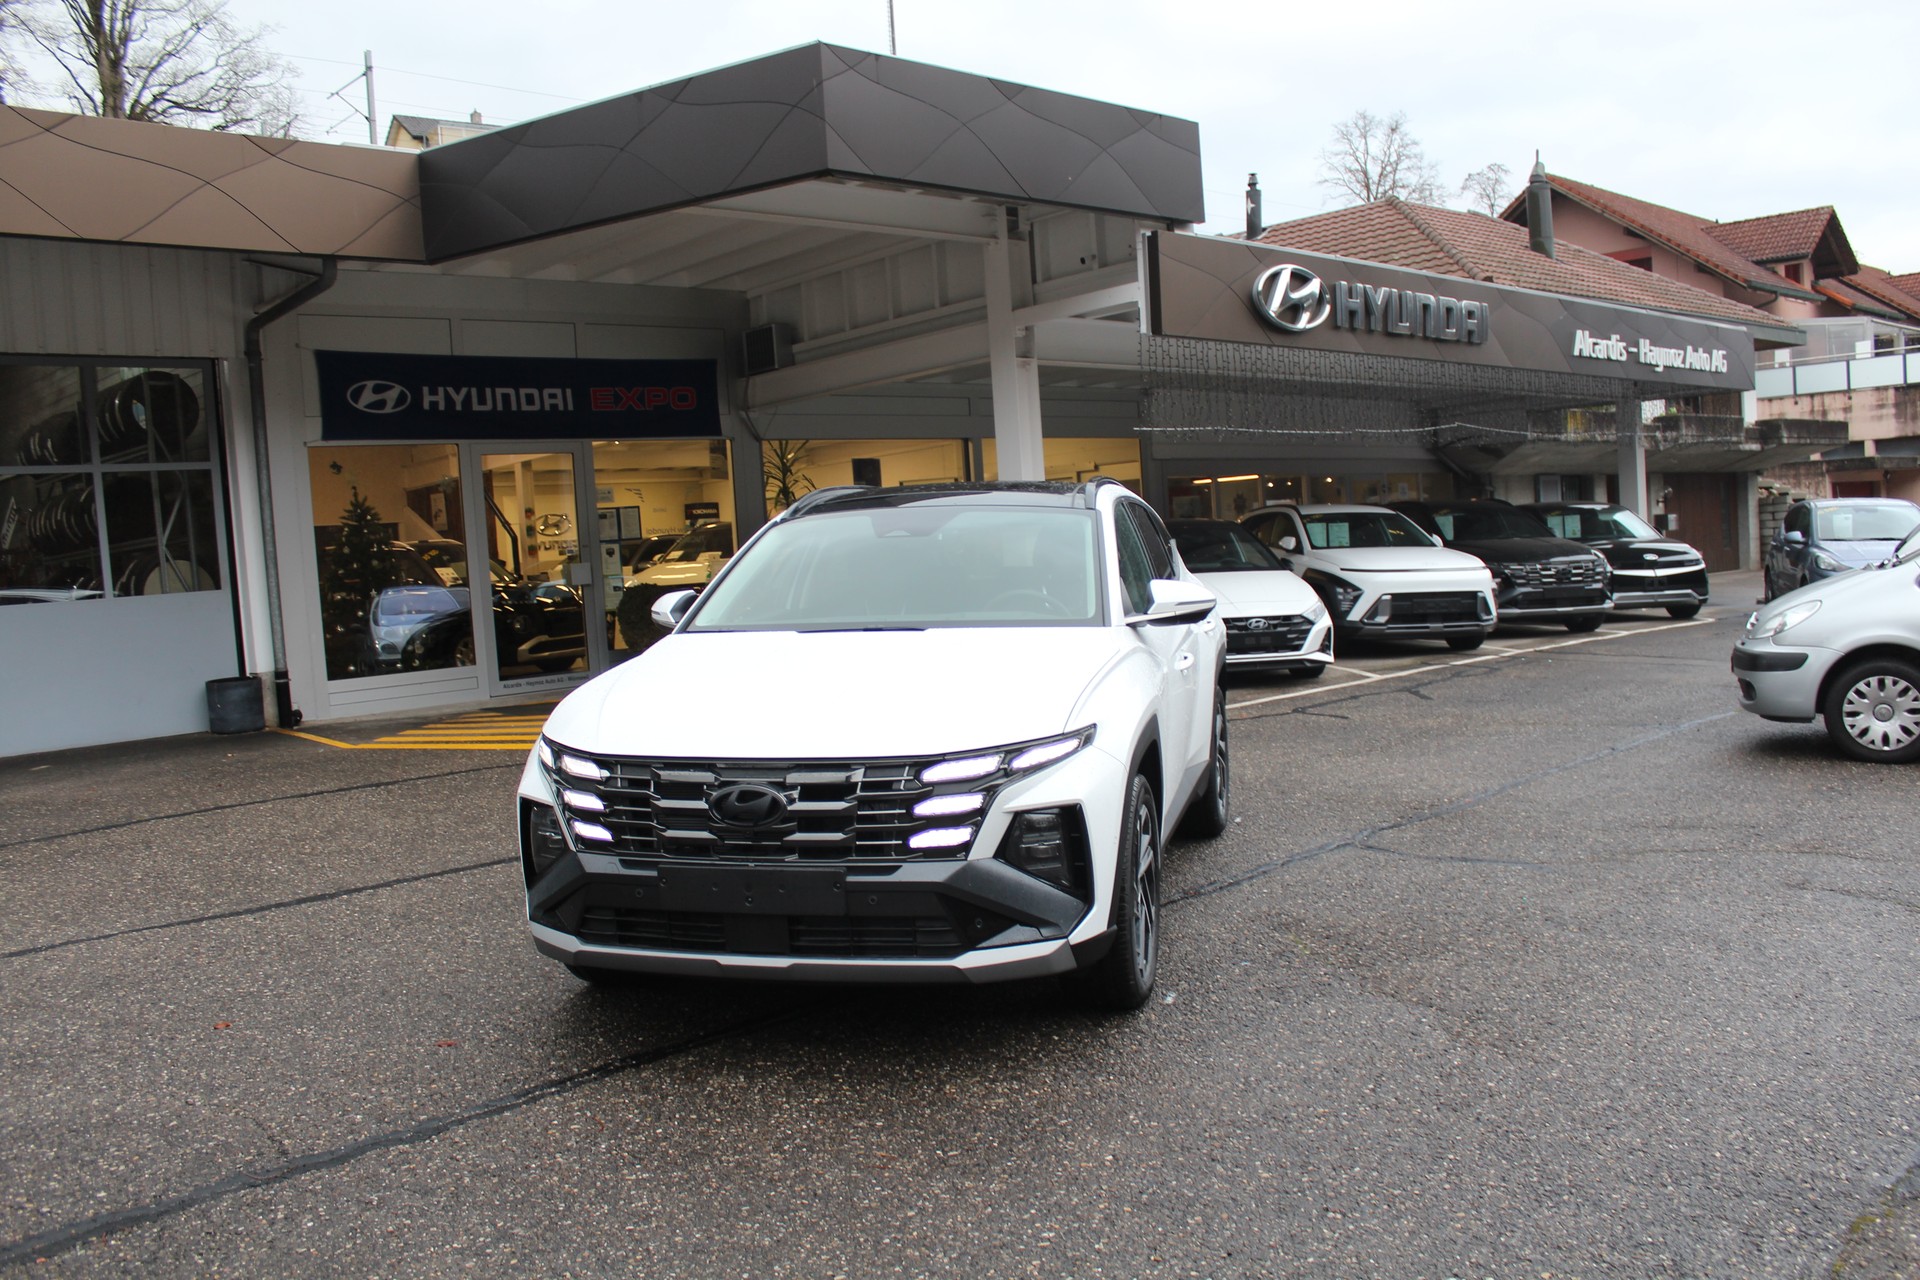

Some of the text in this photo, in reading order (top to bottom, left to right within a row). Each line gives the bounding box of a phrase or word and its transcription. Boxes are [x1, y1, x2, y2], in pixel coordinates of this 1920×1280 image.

[1335, 280, 1488, 344] HYUNDAI
[1573, 329, 1627, 361] Alcardis
[1638, 338, 1685, 372] Haymoz
[1685, 345, 1710, 371] Auto
[1711, 349, 1728, 373] AG
[422, 386, 697, 411] HYUNDAI EXPO
